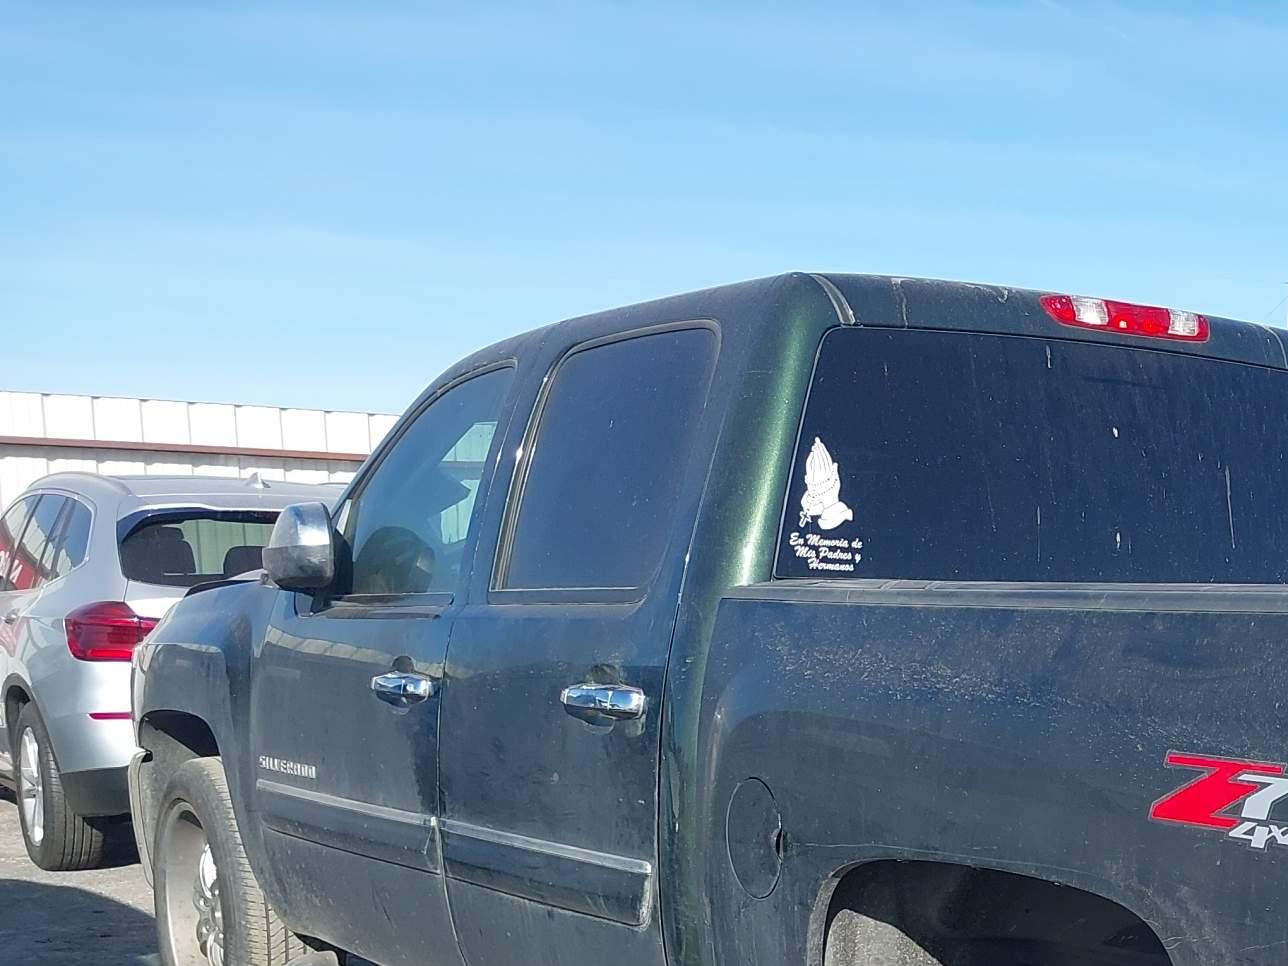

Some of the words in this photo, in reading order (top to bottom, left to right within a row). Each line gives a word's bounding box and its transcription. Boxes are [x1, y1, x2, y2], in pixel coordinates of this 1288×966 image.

[790, 532, 804, 545] En
[806, 534, 849, 548] Memoria
[851, 538, 863, 549] de
[794, 546, 816, 558] Mis
[818, 547, 852, 560] Padres
[855, 553, 862, 564] y
[808, 558, 854, 571] Hermanos
[259, 755, 316, 779] SILVERADO
